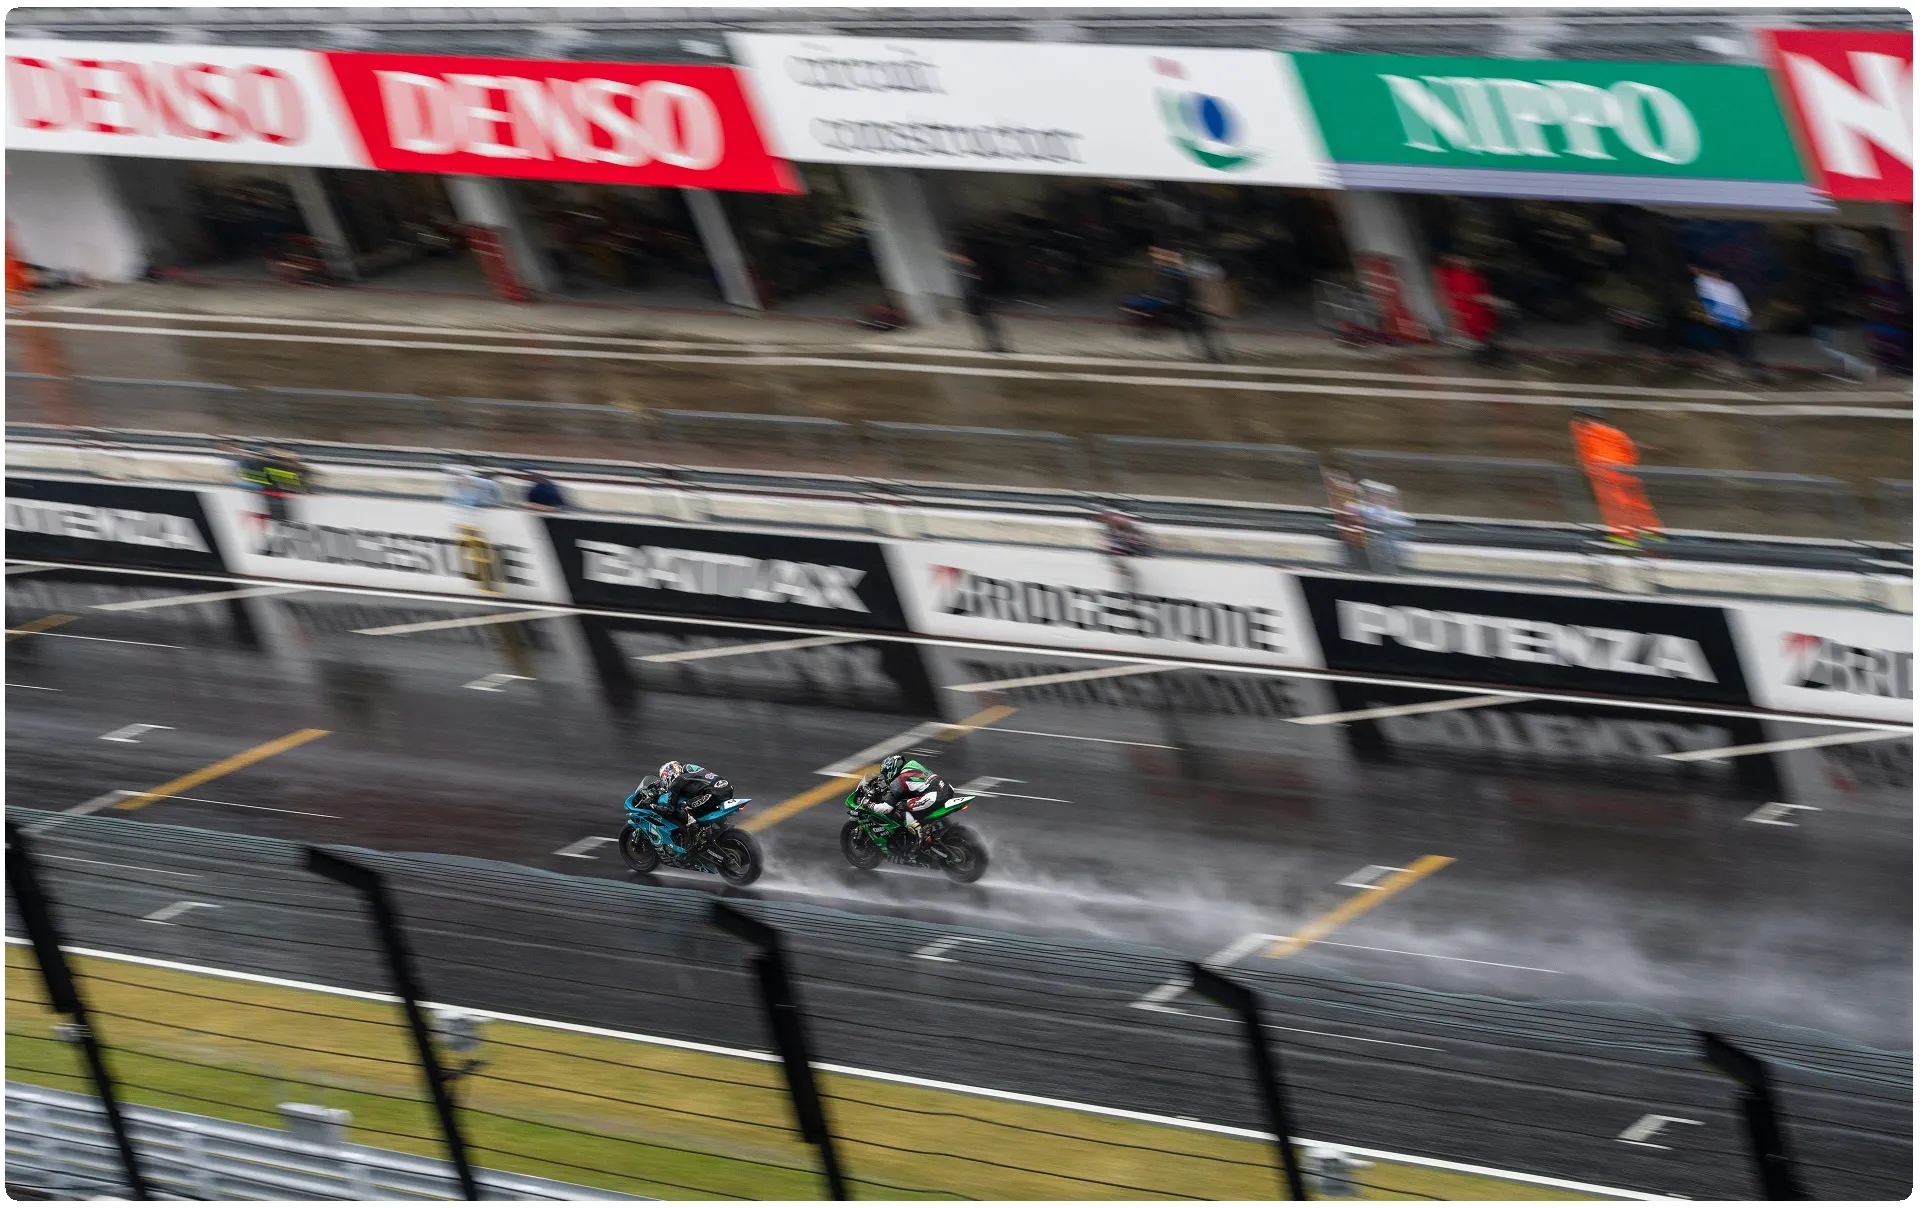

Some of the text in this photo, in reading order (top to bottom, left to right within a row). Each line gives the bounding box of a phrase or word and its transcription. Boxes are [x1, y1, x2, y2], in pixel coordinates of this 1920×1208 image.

[5, 55, 310, 147] DENSO
[372, 69, 726, 170] DENSO
[1375, 73, 1701, 165] NIPPO
[926, 562, 1288, 654] BRIDGESTONE
[1334, 599, 1718, 684] POTENZA
